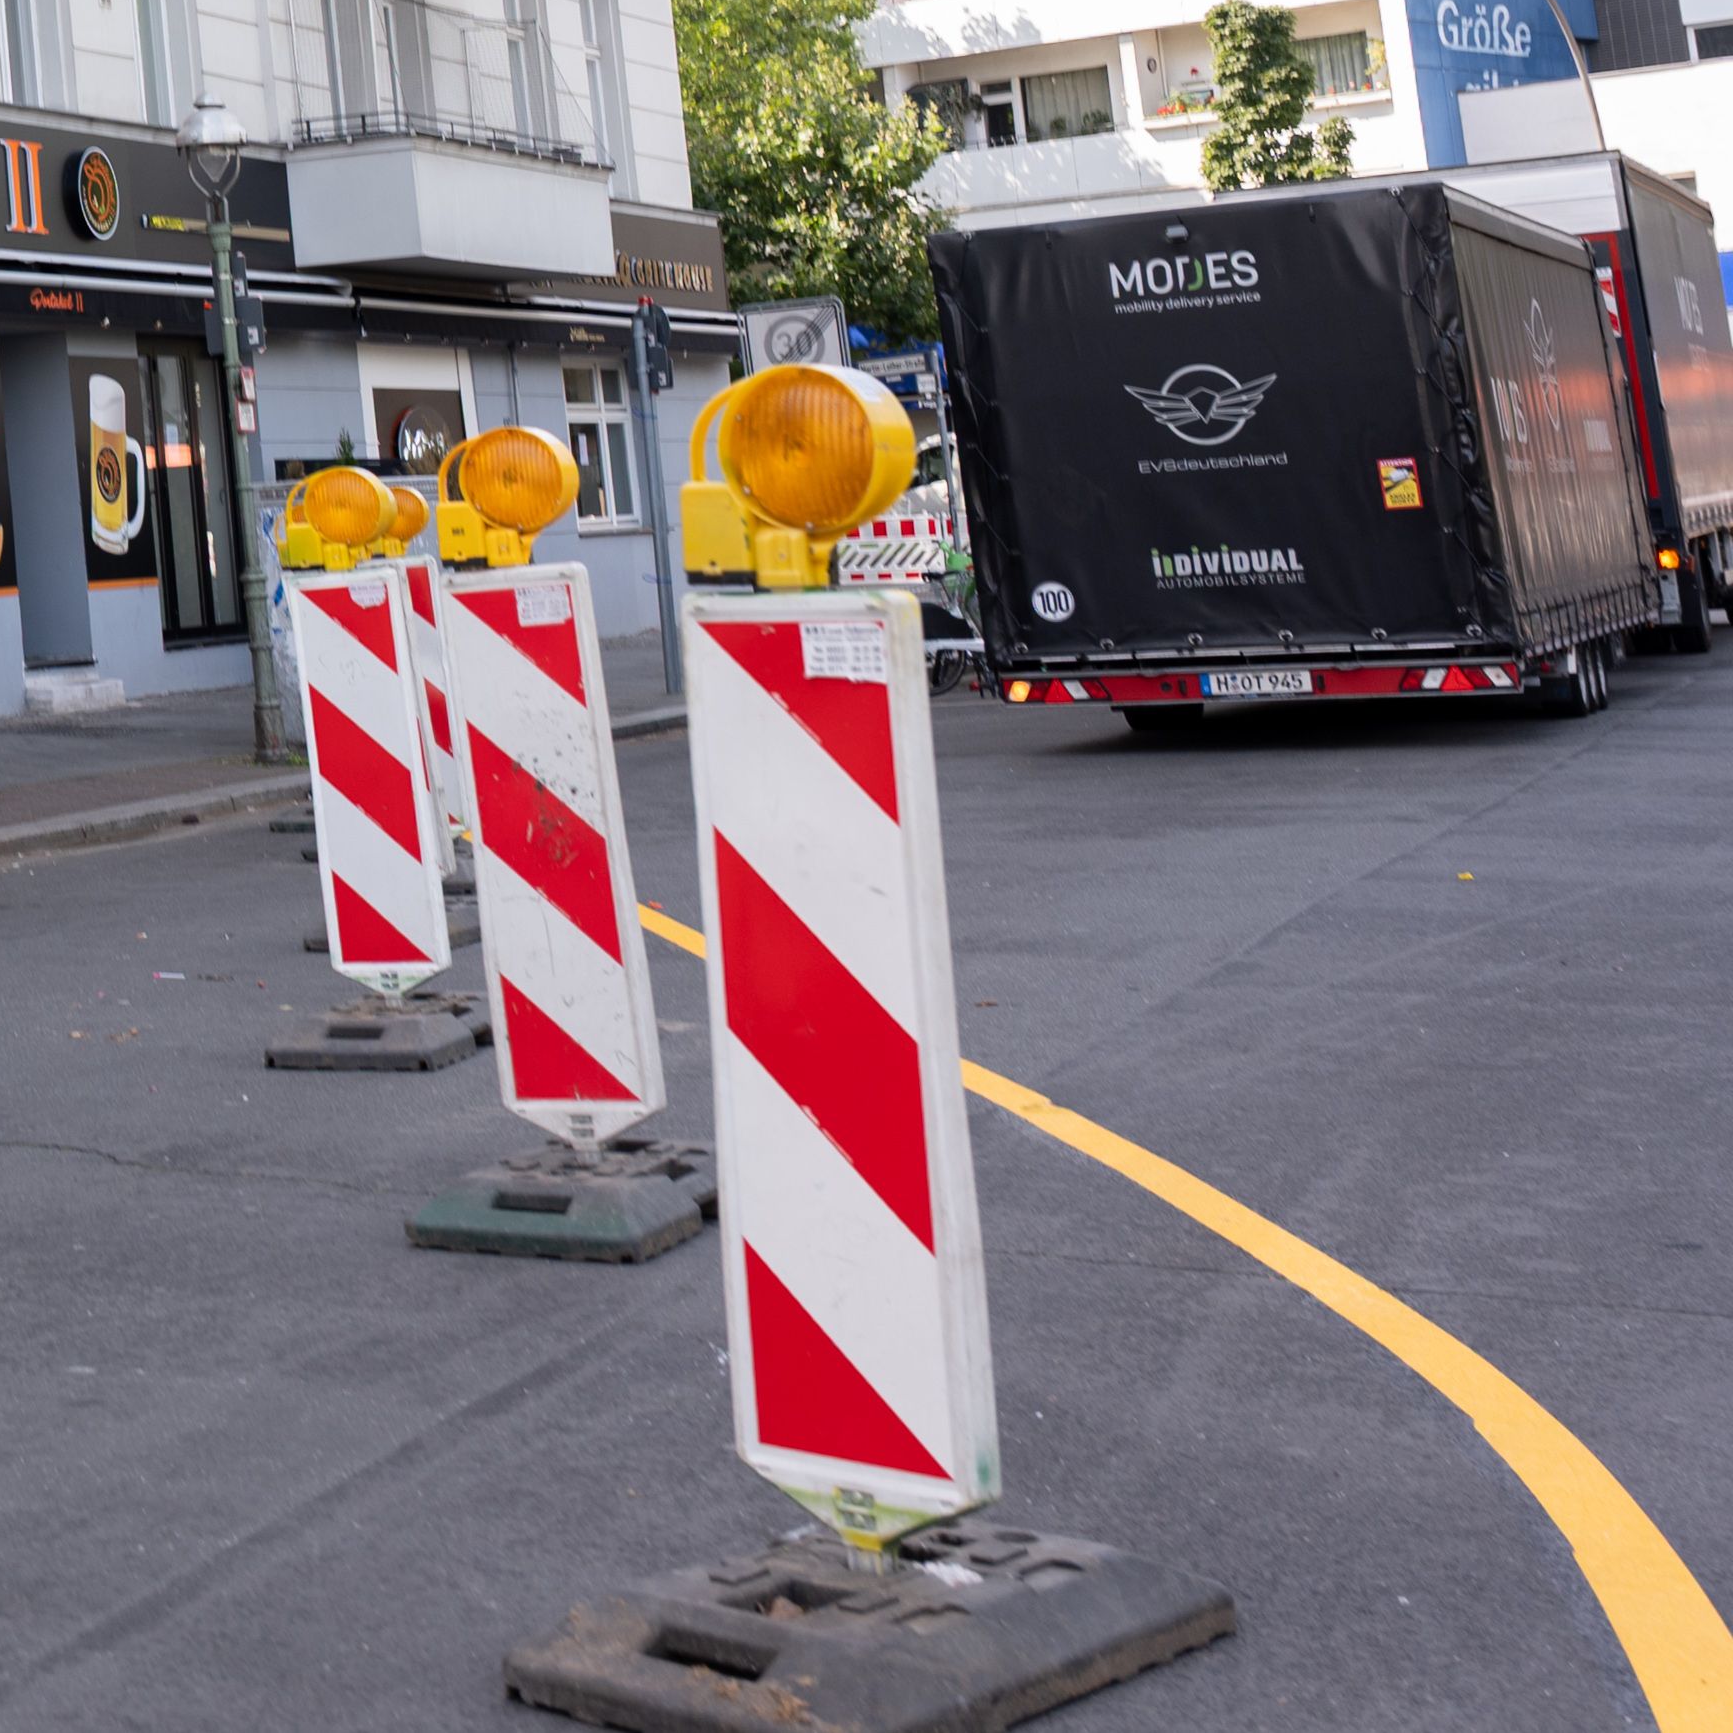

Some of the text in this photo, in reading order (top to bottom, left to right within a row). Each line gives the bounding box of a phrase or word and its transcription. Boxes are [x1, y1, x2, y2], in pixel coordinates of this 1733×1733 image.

[0, 138, 49, 236] II
[1108, 250, 1260, 299] MODES
[1115, 291, 1261, 315] mobility delivery service
[775, 328, 813, 362] 30
[1156, 572, 1306, 590] AUTOMOBILSYSTEME
[1037, 590, 1071, 615] 100
[1216, 675, 1229, 692] H
